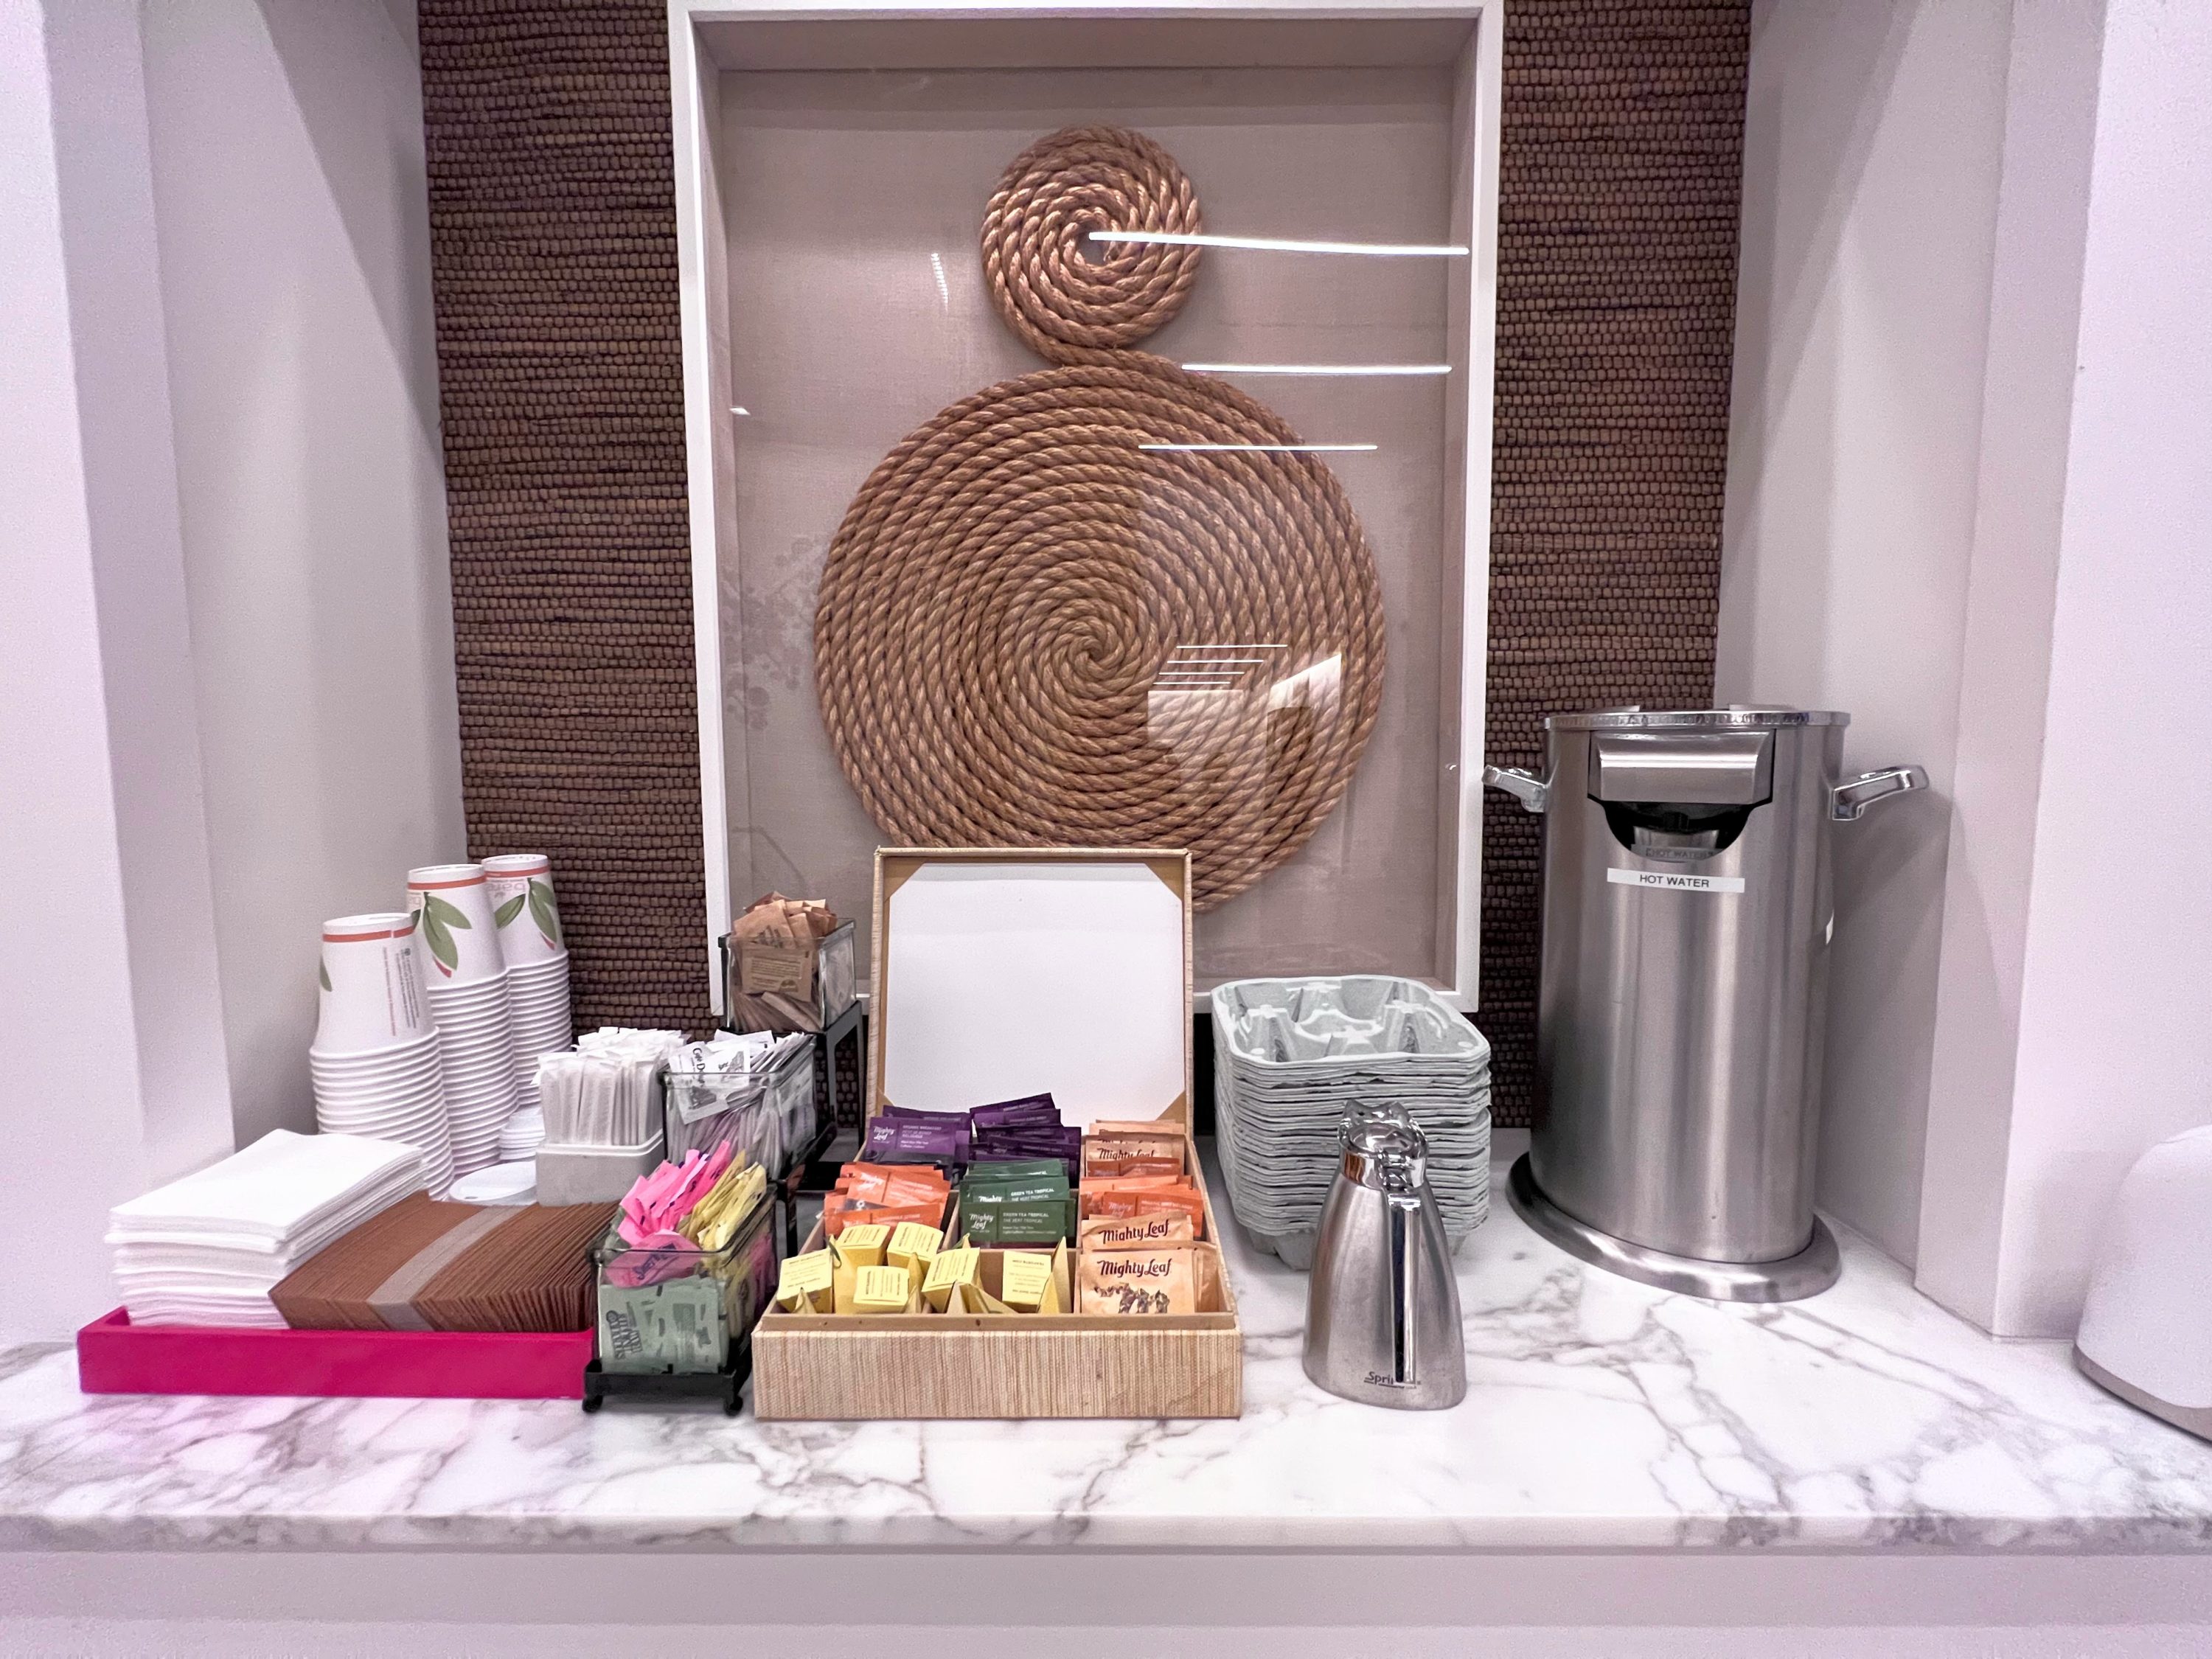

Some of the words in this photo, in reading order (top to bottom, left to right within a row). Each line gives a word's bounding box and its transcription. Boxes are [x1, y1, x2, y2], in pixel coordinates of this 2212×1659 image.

[1640, 874, 1663, 884] HOT
[1667, 877, 1710, 888] WATER
[969, 1213, 995, 1222] Mighty
[970, 1220, 987, 1230] Leaf
[1098, 1226, 1144, 1245] Mighty
[1144, 1218, 1169, 1238] Leaf
[1096, 1259, 1144, 1278] Mighty
[1144, 1258, 1172, 1276] Leaf
